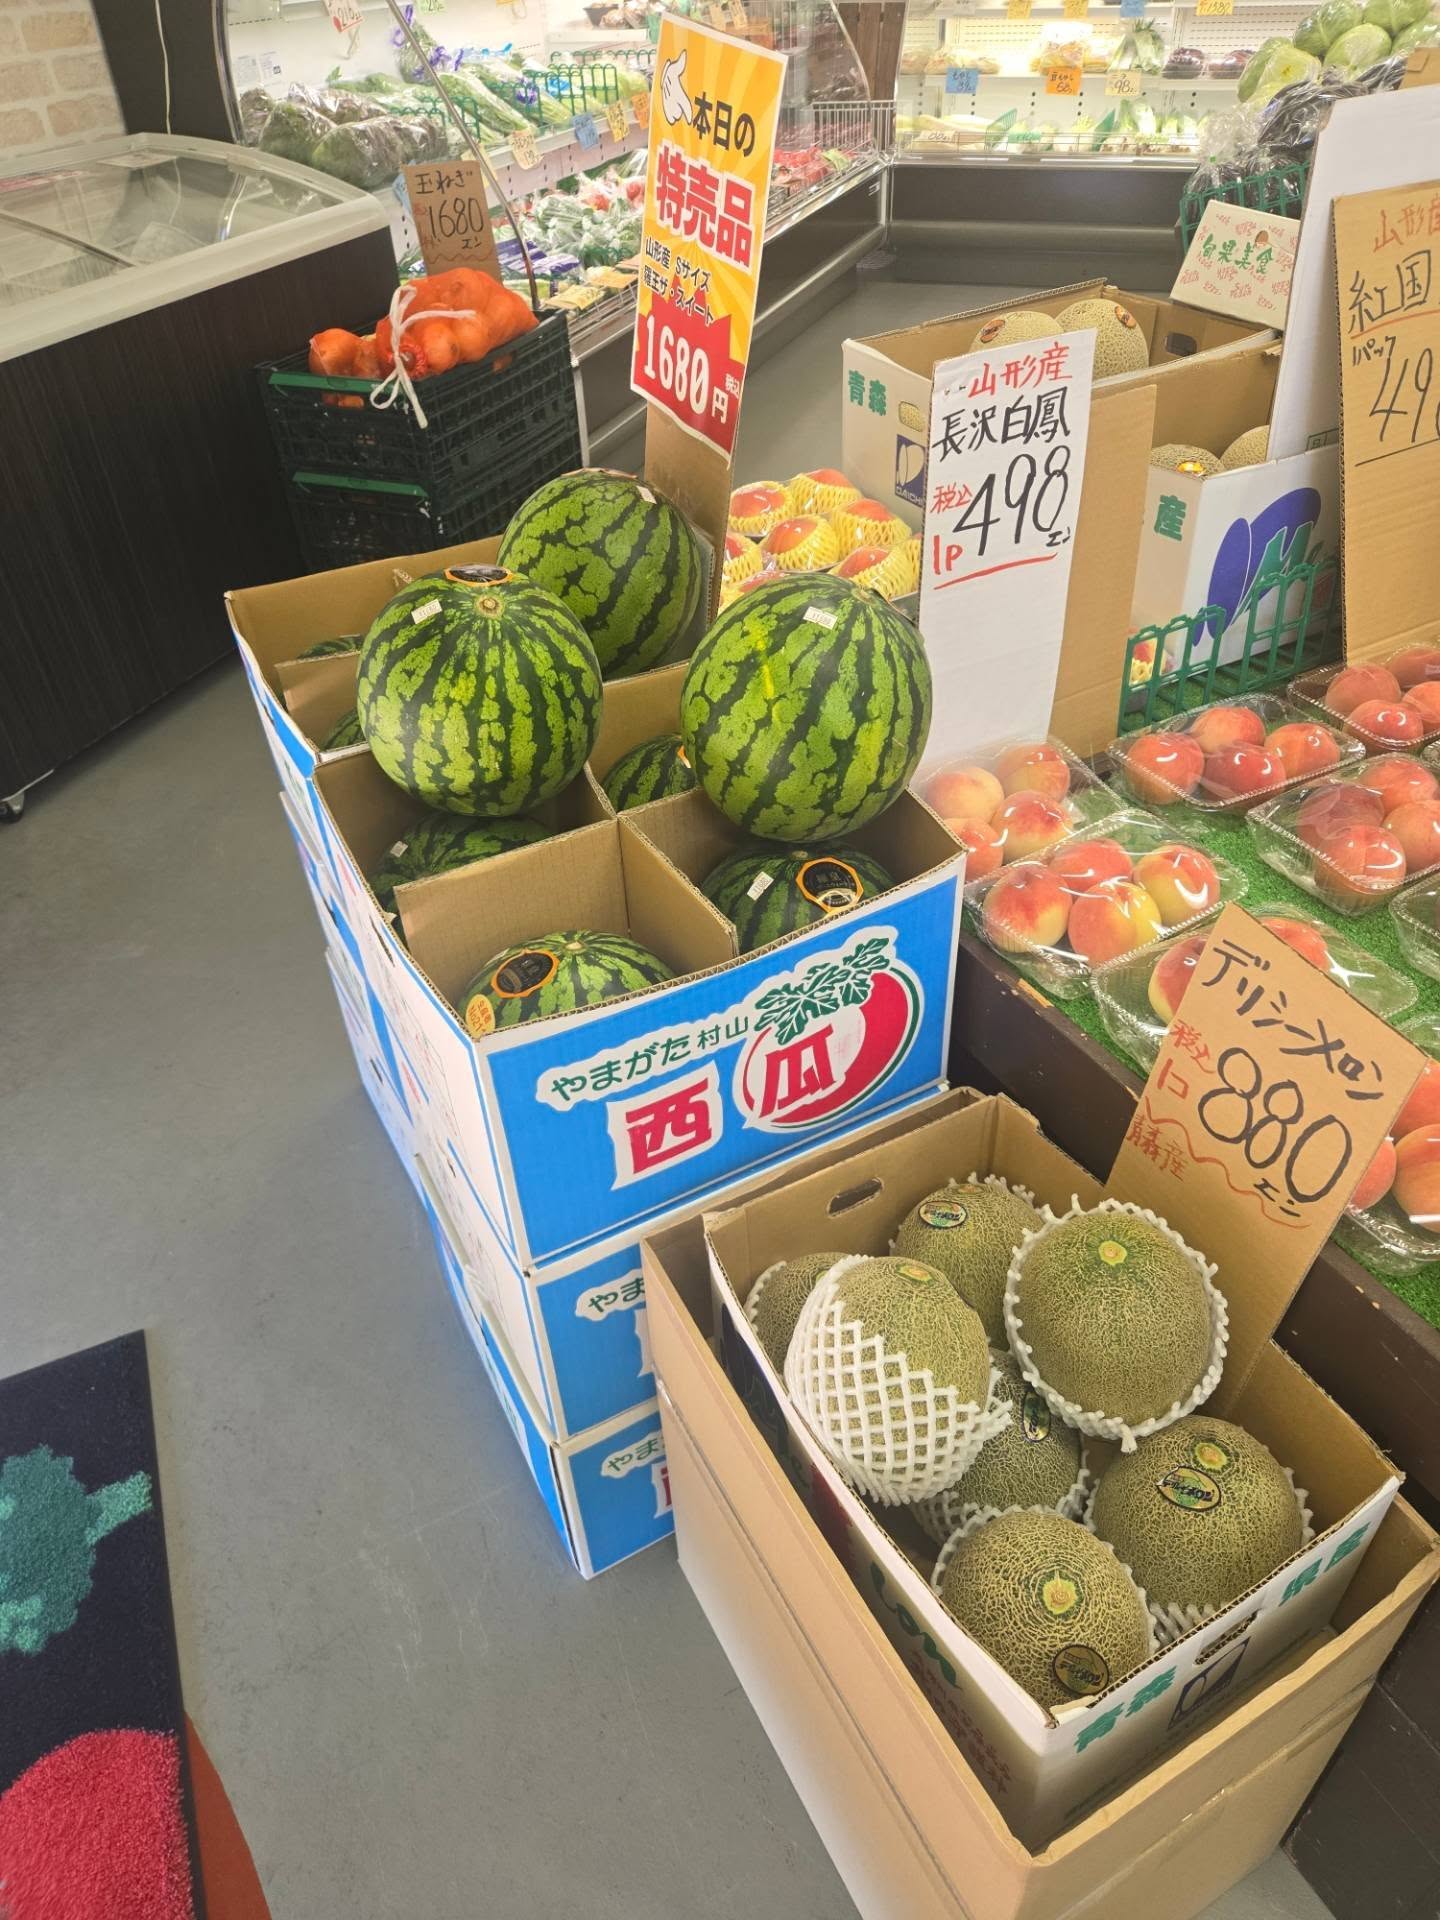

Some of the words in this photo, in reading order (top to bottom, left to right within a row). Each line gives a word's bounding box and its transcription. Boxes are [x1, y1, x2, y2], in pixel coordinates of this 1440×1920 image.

[693, 91, 756, 157] 本日の
[415, 169, 473, 195] 玉ねぎ
[656, 143, 754, 269] 特売品
[429, 197, 484, 239] 1680
[645, 237, 671, 269] 山形産
[675, 256, 711, 292] Sサイズ
[644, 315, 710, 415] 1680
[968, 341, 1073, 398] 山形産
[711, 386, 729, 424] 円
[932, 386, 1071, 462] 長沢白鳳
[930, 482, 973, 514] 税込
[952, 445, 1071, 556] 498
[1198, 1047, 1352, 1204] 880
